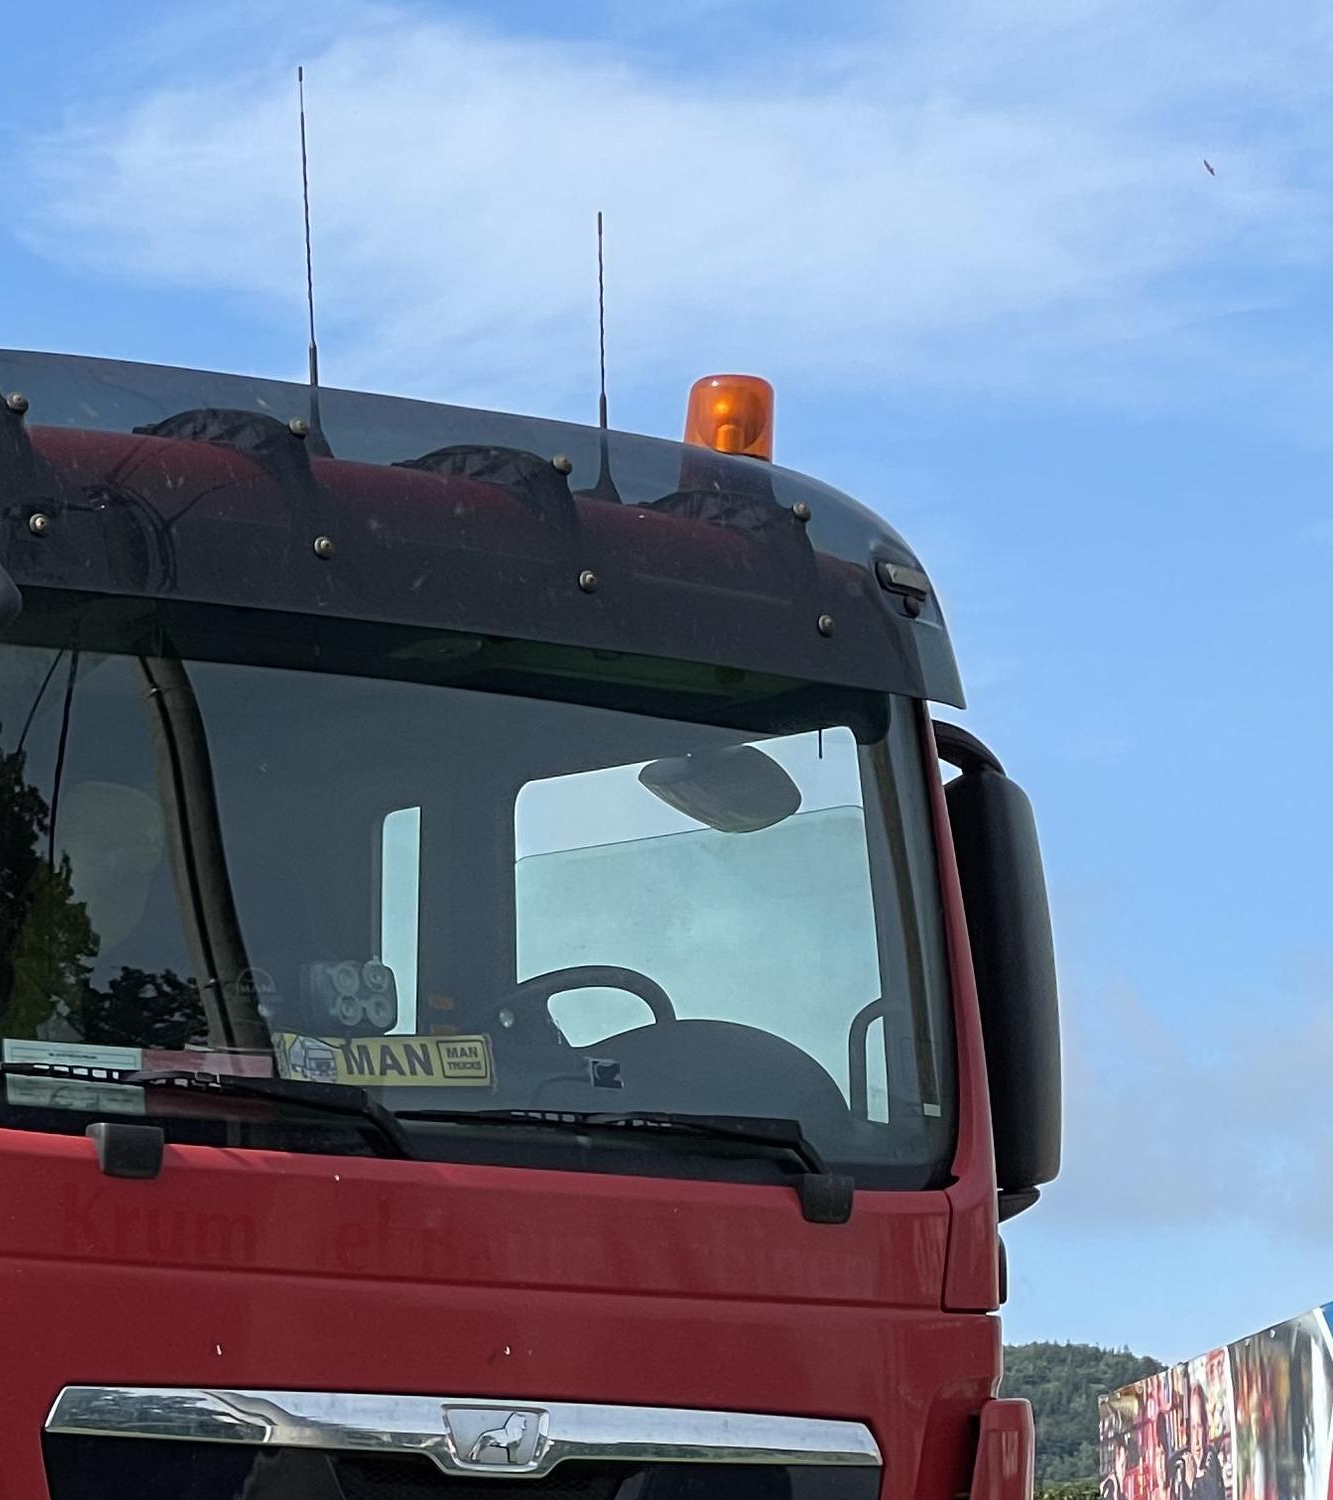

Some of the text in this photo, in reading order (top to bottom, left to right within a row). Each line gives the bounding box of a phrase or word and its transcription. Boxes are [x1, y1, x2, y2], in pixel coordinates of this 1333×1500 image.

[446, 1046, 479, 1059] MAN
[342, 1042, 435, 1077] MAN
[447, 1059, 483, 1072] TRUCKS
